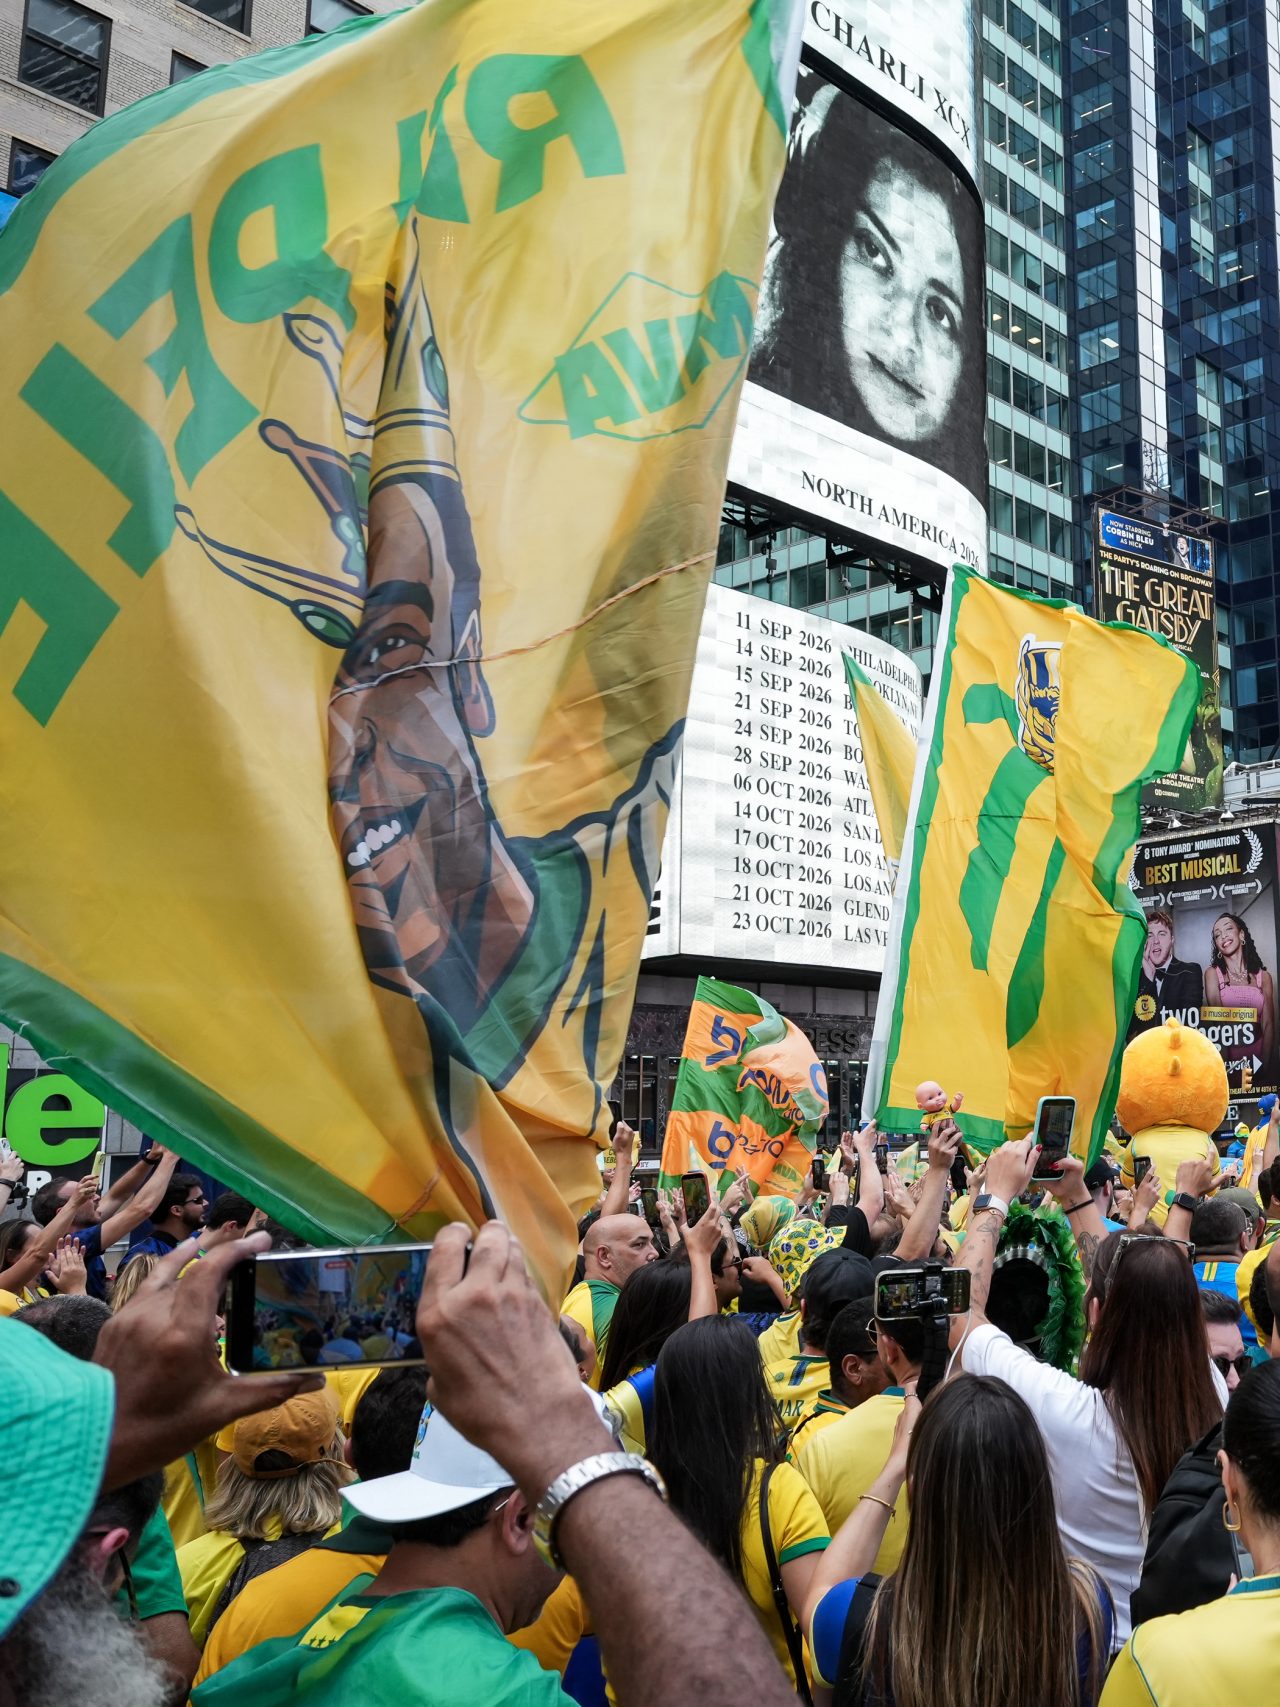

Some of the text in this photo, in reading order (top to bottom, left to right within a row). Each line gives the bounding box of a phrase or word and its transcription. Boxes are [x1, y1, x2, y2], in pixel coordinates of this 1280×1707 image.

[811, 1, 971, 151] CHARLI XCX
[802, 471, 981, 571] NORTH AMERICA 2026
[1106, 526, 1154, 546] CORBIN BLEU
[1110, 519, 1151, 537] NOW STARRING
[1128, 540, 1142, 549] NICK
[1100, 550, 1212, 588] THE PARTY'S ROARING ON BROADWAY
[1103, 566, 1213, 621] THE GREAT
[735, 611, 752, 630] 11
[760, 619, 792, 640] SEP
[799, 631, 832, 652] 2026
[1116, 601, 1201, 645] GATSBY
[736, 639, 753, 656] 14
[760, 646, 792, 666] SEP
[799, 657, 832, 678] 2026
[736, 666, 753, 683] 15
[760, 672, 792, 692] SEP
[799, 682, 832, 703] 2026
[734, 692, 750, 709] 21
[760, 699, 792, 718] SEP
[799, 708, 832, 729] 2026
[734, 719, 753, 736] 24
[760, 724, 792, 744] SEP
[798, 734, 832, 754] 2026
[734, 746, 832, 780] 28 SEP 2026
[1179, 774, 1204, 785] THEATRE
[733, 773, 752, 790] 06
[757, 778, 793, 798] OCT
[798, 787, 832, 806] 2026
[1162, 778, 1194, 790] BROADWAY
[735, 802, 752, 818] 14
[757, 806, 793, 825] OCT
[798, 813, 832, 832] 2026
[843, 821, 871, 844] SAN
[735, 829, 752, 845] 17
[756, 833, 793, 852] OCT
[798, 839, 832, 858] 2026
[844, 847, 871, 867] LOS
[1144, 848, 1150, 859] 8
[1151, 846, 1168, 858] TONY
[1194, 835, 1240, 851] NOMINATIONS
[734, 856, 752, 874] 18
[756, 860, 793, 879] OCT
[798, 866, 832, 884] 2026
[844, 873, 871, 893] LOS
[1145, 854, 1241, 886] BEST MUSICAL
[732, 884, 749, 901] 21
[756, 888, 793, 906] OCT
[798, 893, 832, 911] 2026
[732, 912, 751, 929] 23
[756, 915, 793, 933] OCT
[798, 920, 832, 937] 2026
[844, 925, 871, 945] LAS
[1160, 1006, 1199, 1028] two
[1208, 1009, 1232, 1018] musical
[1232, 1009, 1255, 1020] original
